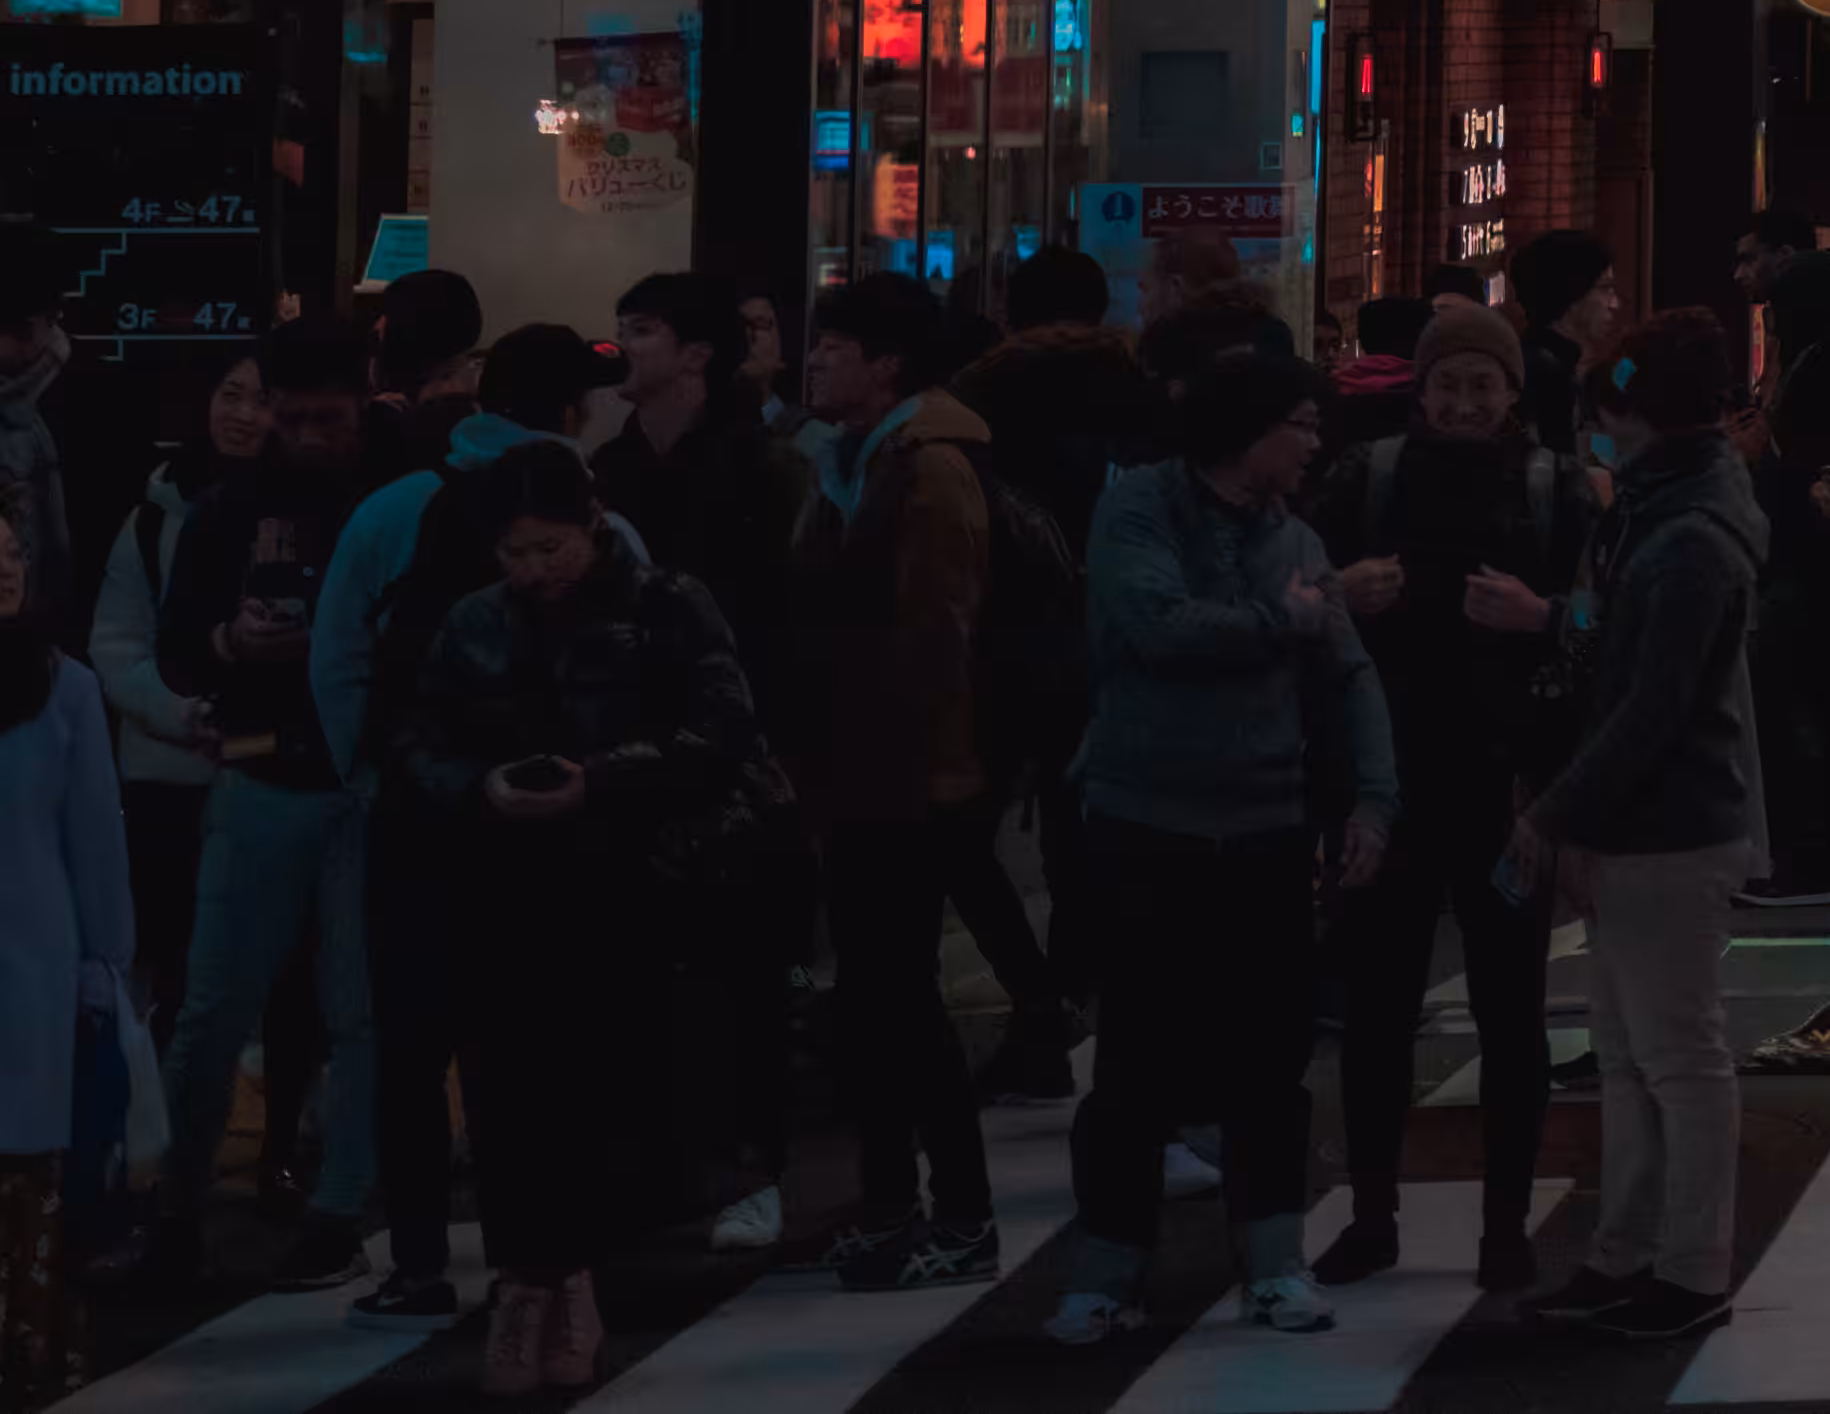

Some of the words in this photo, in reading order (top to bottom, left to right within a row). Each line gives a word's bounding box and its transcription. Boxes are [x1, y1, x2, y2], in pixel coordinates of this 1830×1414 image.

[9, 62, 243, 96] information
[120, 196, 161, 224] 4F
[118, 302, 158, 331] 3F
